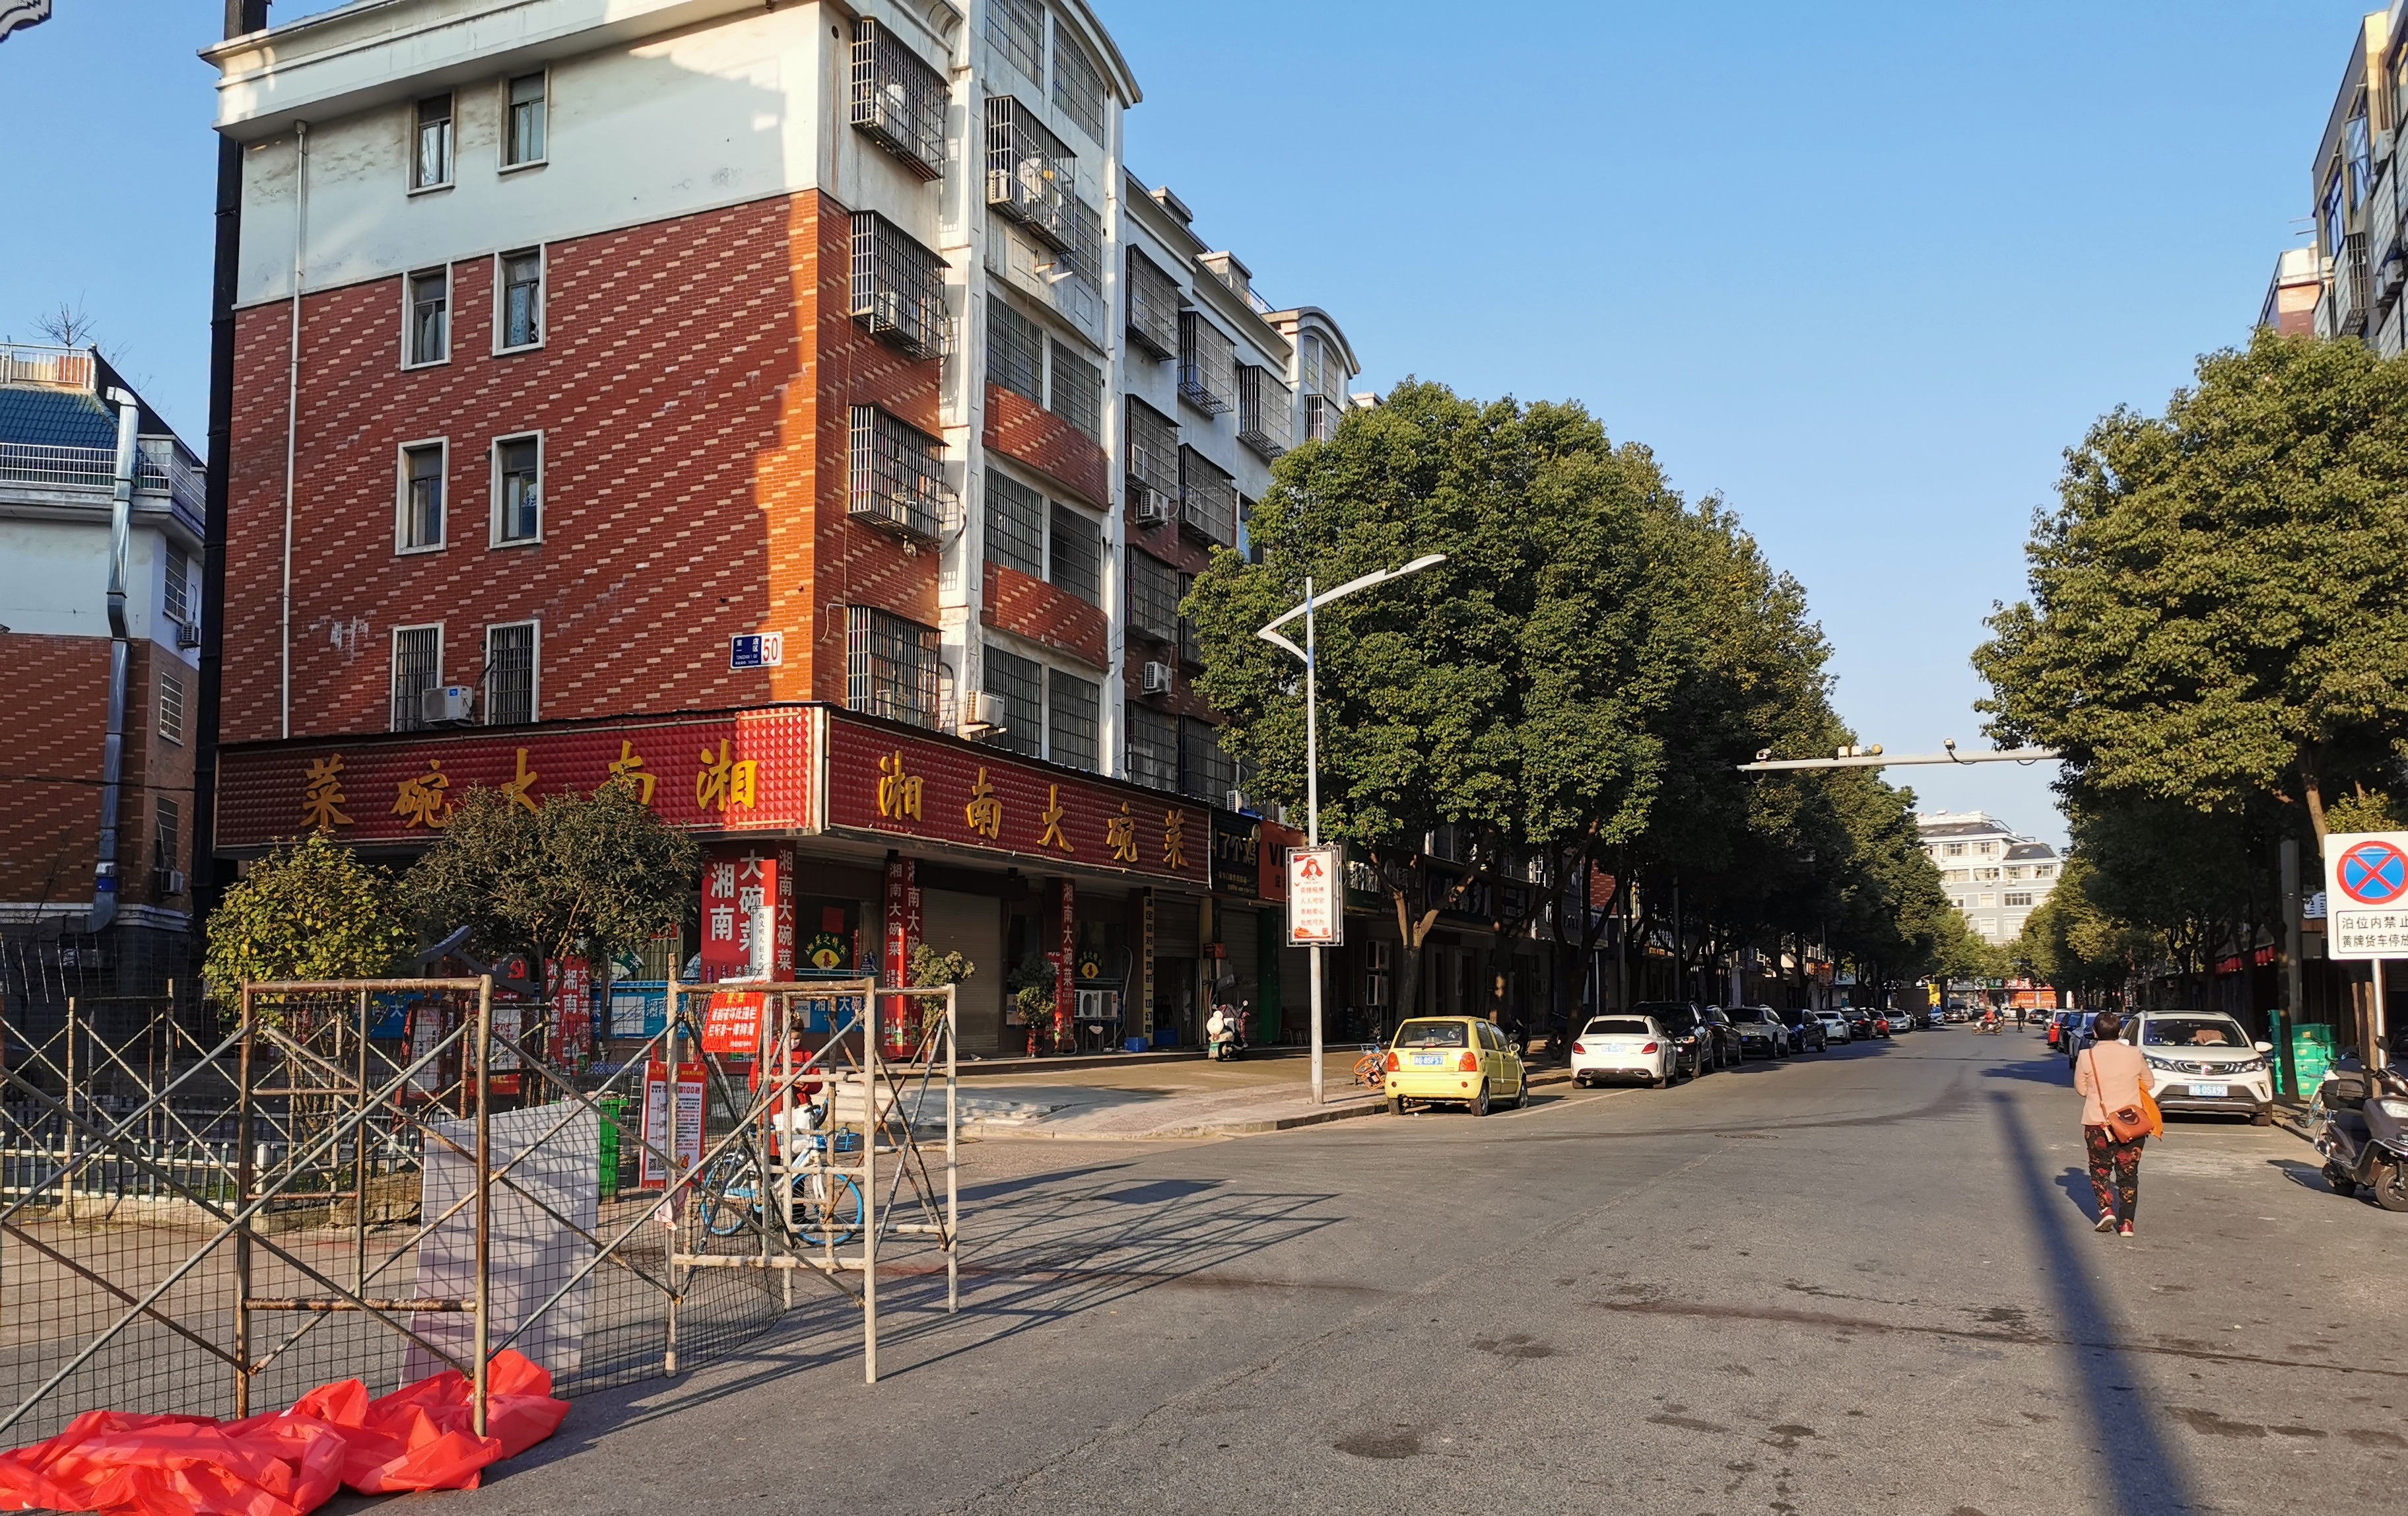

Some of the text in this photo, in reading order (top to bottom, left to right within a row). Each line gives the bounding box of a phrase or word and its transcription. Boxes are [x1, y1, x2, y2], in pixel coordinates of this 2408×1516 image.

[764, 637, 778, 661] 50
[879, 749, 1188, 870] 湘南大碗菜
[710, 862, 735, 942] 湘南
[777, 849, 793, 971] 湘南大碗菜
[888, 863, 902, 956] 湘南大碗菜
[1063, 882, 1073, 986] 湘南大碗菜
[2342, 915, 2408, 930] 泊位内禁止
[2342, 934, 2408, 949] 黄牌货车停放
